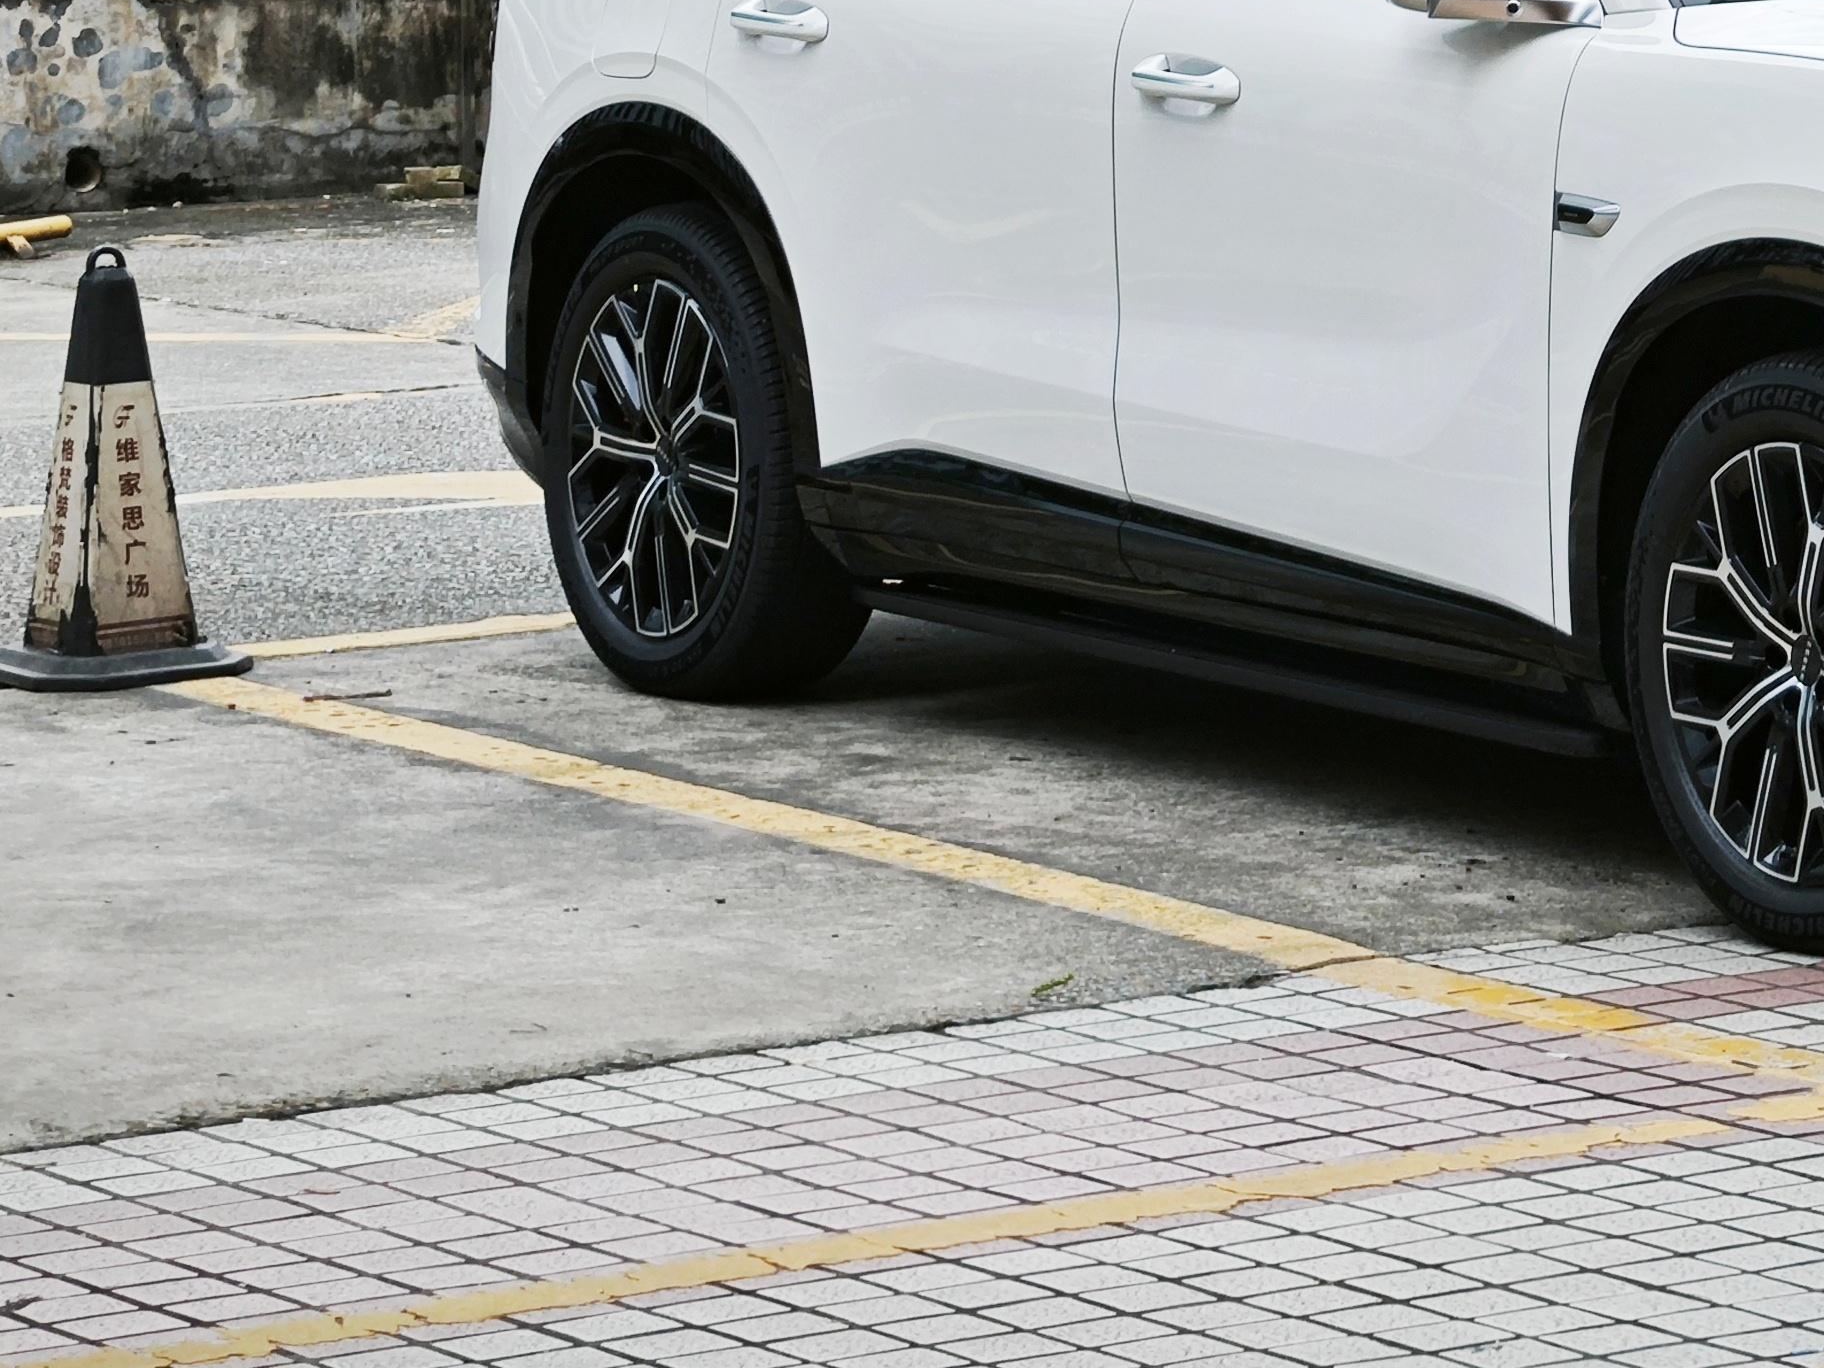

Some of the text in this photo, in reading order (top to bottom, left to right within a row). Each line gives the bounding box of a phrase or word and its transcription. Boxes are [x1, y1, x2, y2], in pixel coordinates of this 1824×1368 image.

[115, 438, 150, 598] 维家思广场
